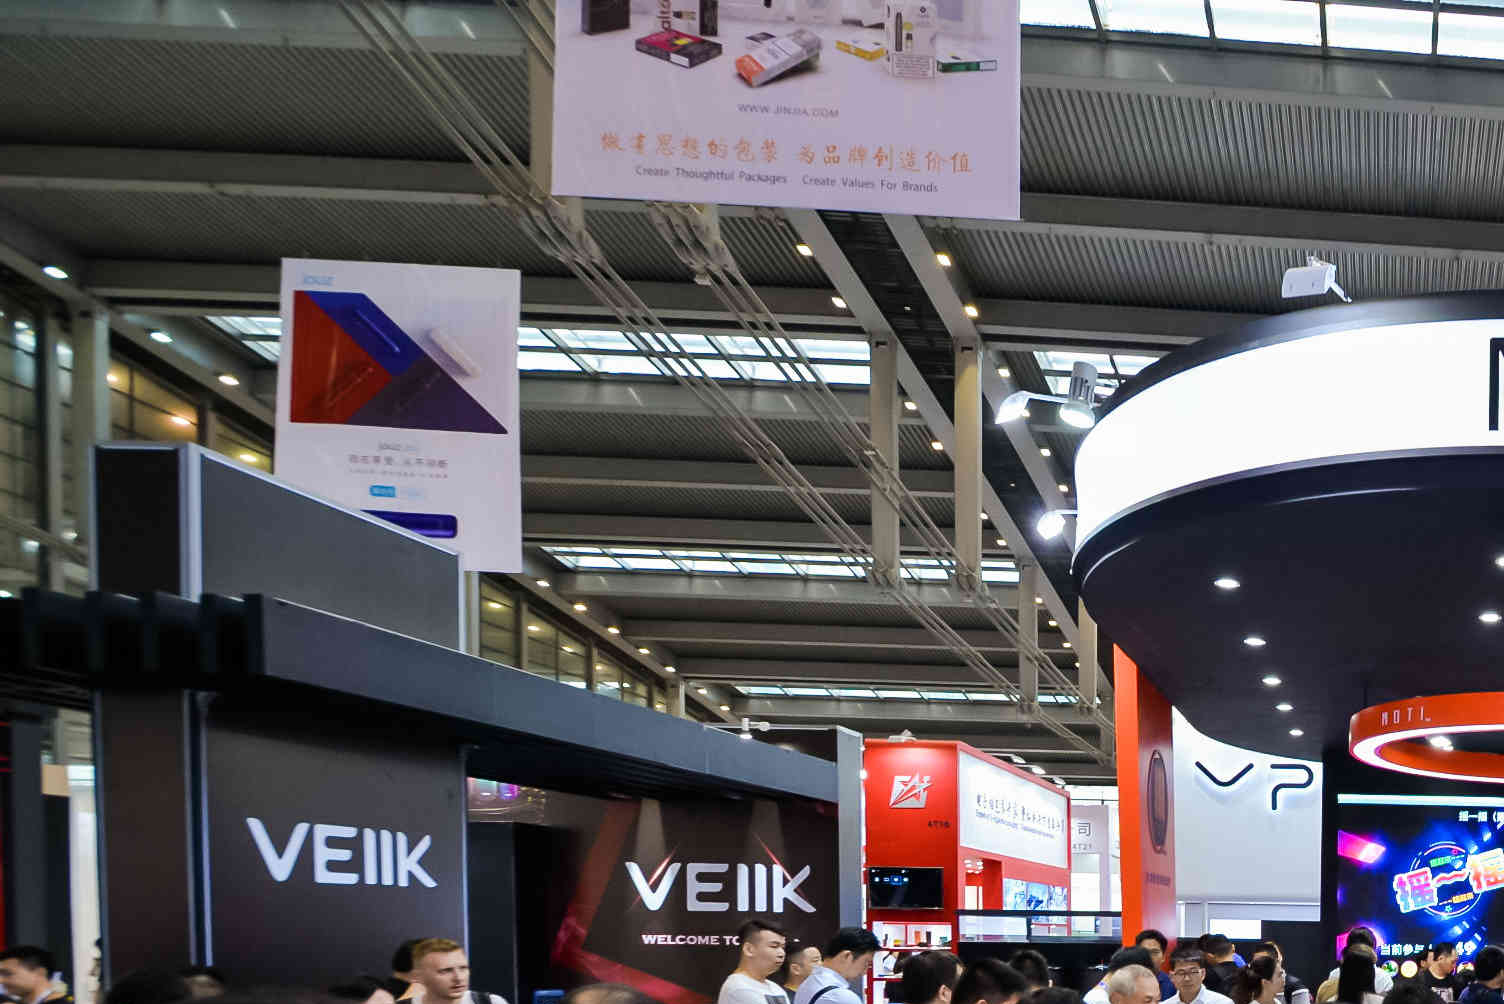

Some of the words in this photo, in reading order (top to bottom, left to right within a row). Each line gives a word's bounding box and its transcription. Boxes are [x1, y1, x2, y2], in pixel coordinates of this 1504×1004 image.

[635, 165, 670, 177] Create
[675, 167, 733, 182] Thoughtful
[739, 171, 787, 185] Packages
[802, 174, 836, 187] Create
[842, 177, 875, 189] Values
[880, 179, 898, 191] For
[902, 180, 938, 193] Brands
[1381, 704, 1424, 728] MOTI
[641, 934, 720, 946] WELCOME
